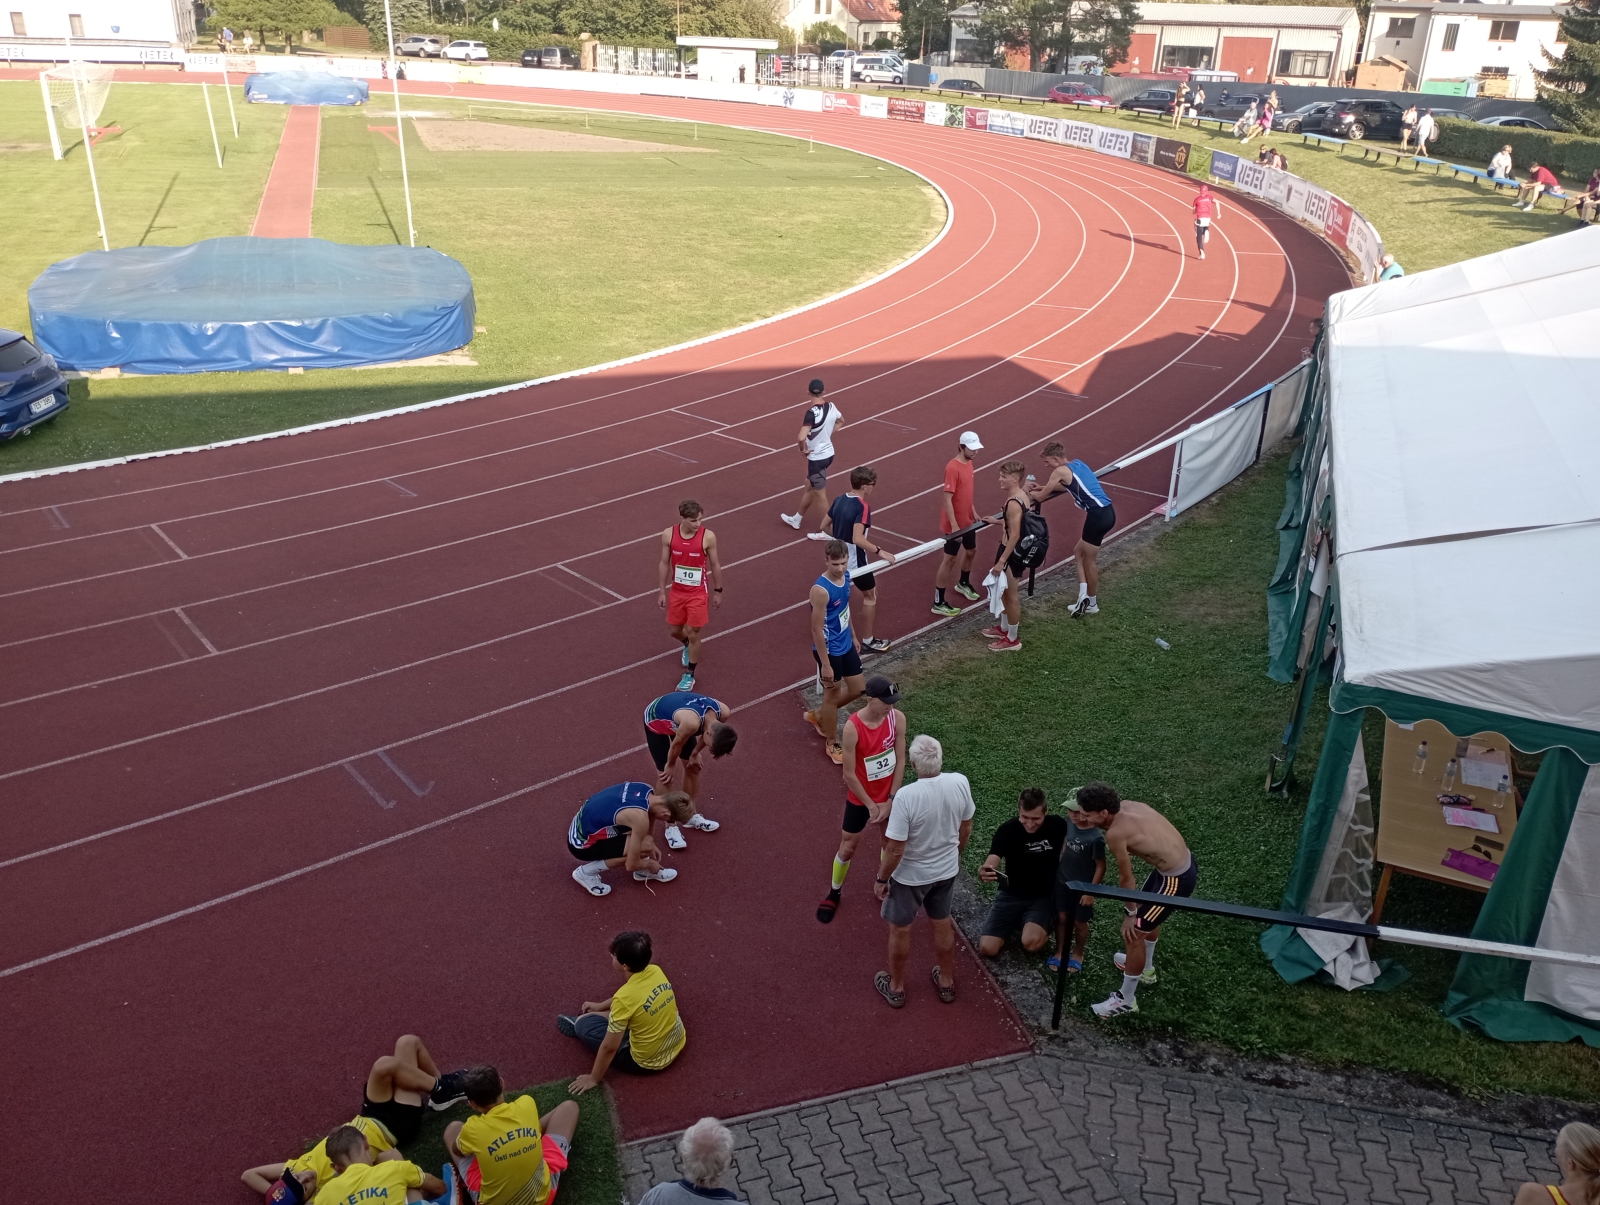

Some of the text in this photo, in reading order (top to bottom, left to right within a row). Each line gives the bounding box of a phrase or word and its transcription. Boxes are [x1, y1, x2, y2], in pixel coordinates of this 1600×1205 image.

[1028, 118, 1059, 138] RIETER
[1064, 124, 1094, 144] RIETER
[1098, 131, 1130, 153] RIETER
[1238, 163, 1266, 191] RIETER
[1304, 190, 1328, 222] RIETER
[682, 571, 694, 579] 10
[876, 757, 890, 770] 32
[487, 1127, 538, 1156] ATLETIKA
[494, 1153, 508, 1163] Ústí
[508, 1149, 522, 1159] nad
